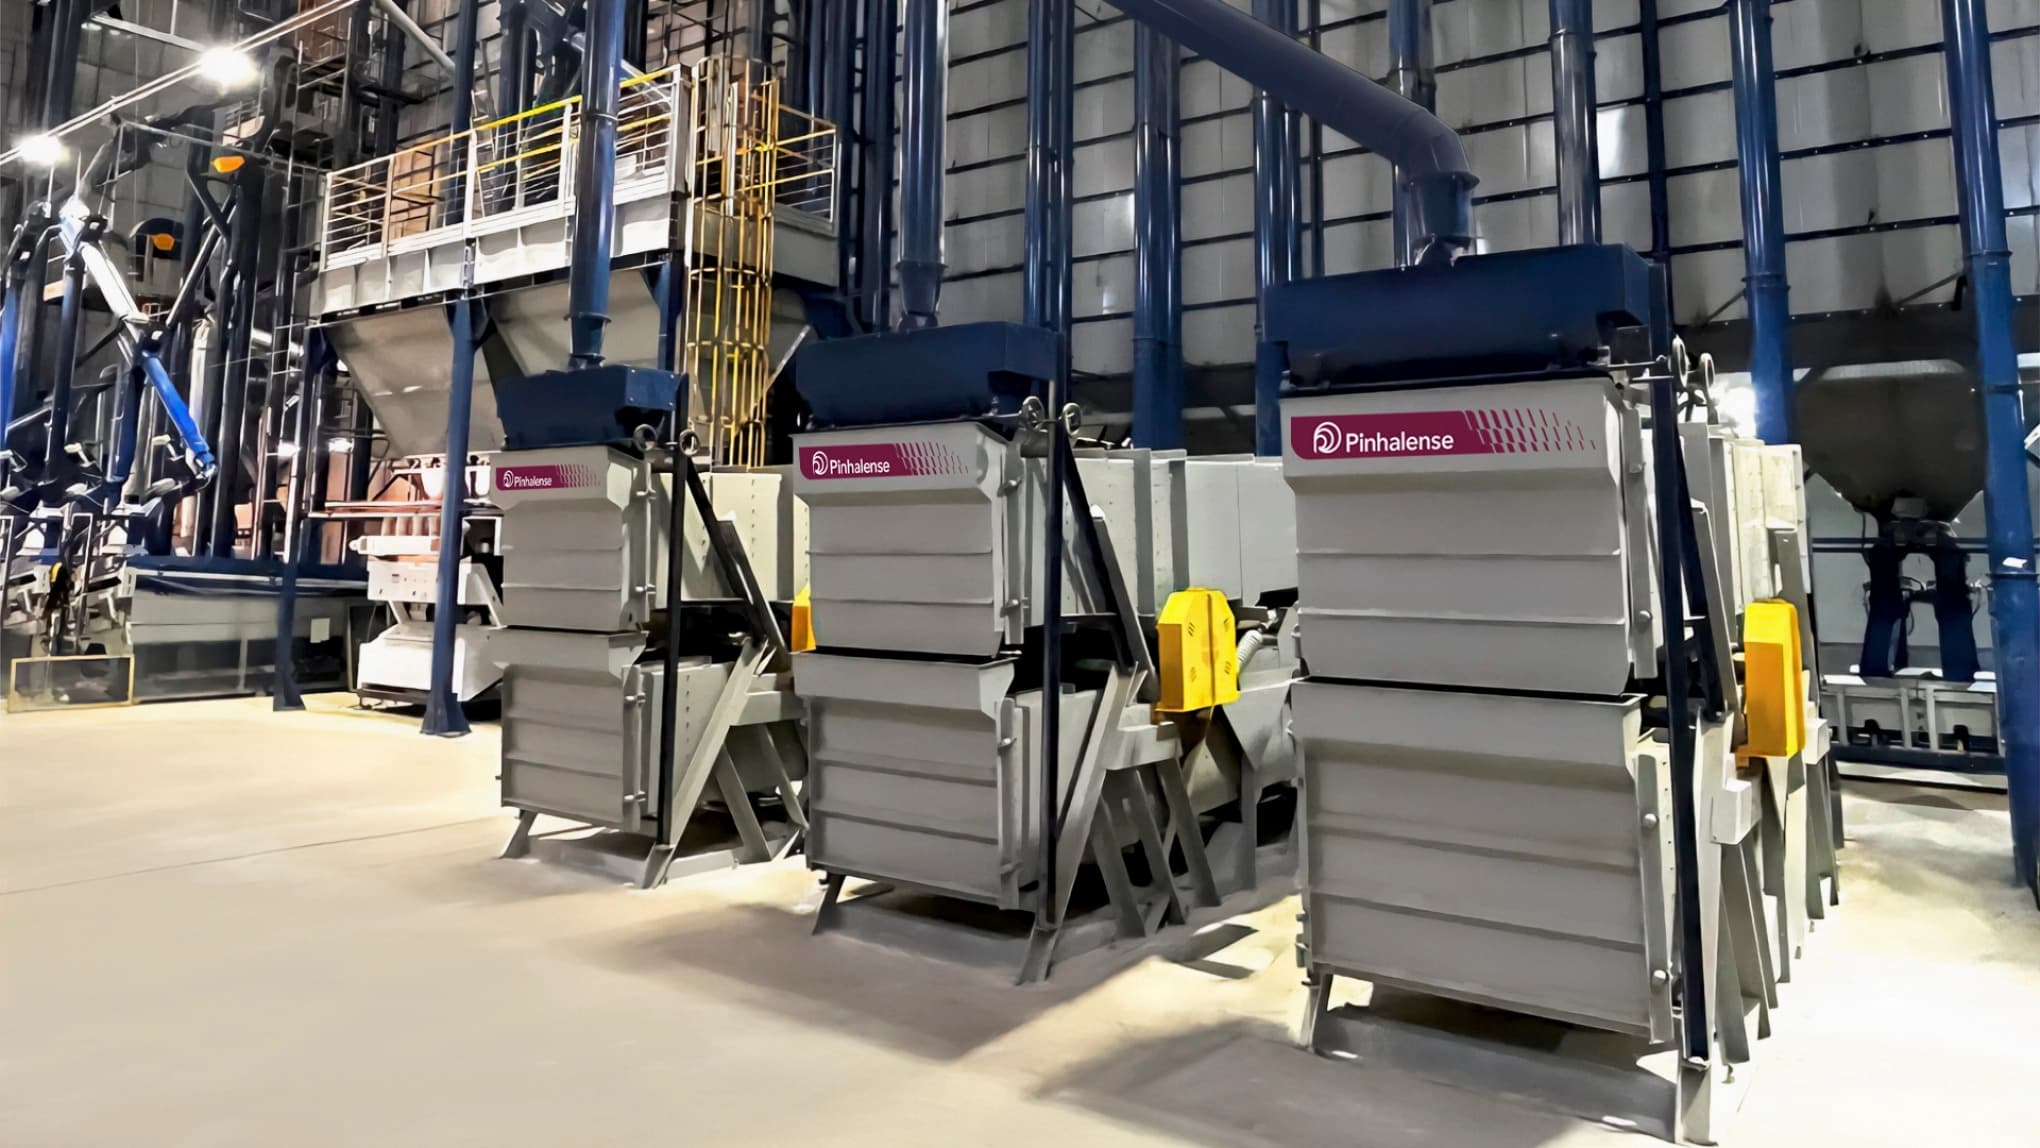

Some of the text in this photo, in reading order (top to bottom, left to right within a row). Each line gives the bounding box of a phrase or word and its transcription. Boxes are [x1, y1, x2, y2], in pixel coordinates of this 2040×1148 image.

[1346, 431, 1454, 453] Pinhalense
[830, 459, 890, 475] Pinhalense
[514, 475, 553, 487] Pinhalense
